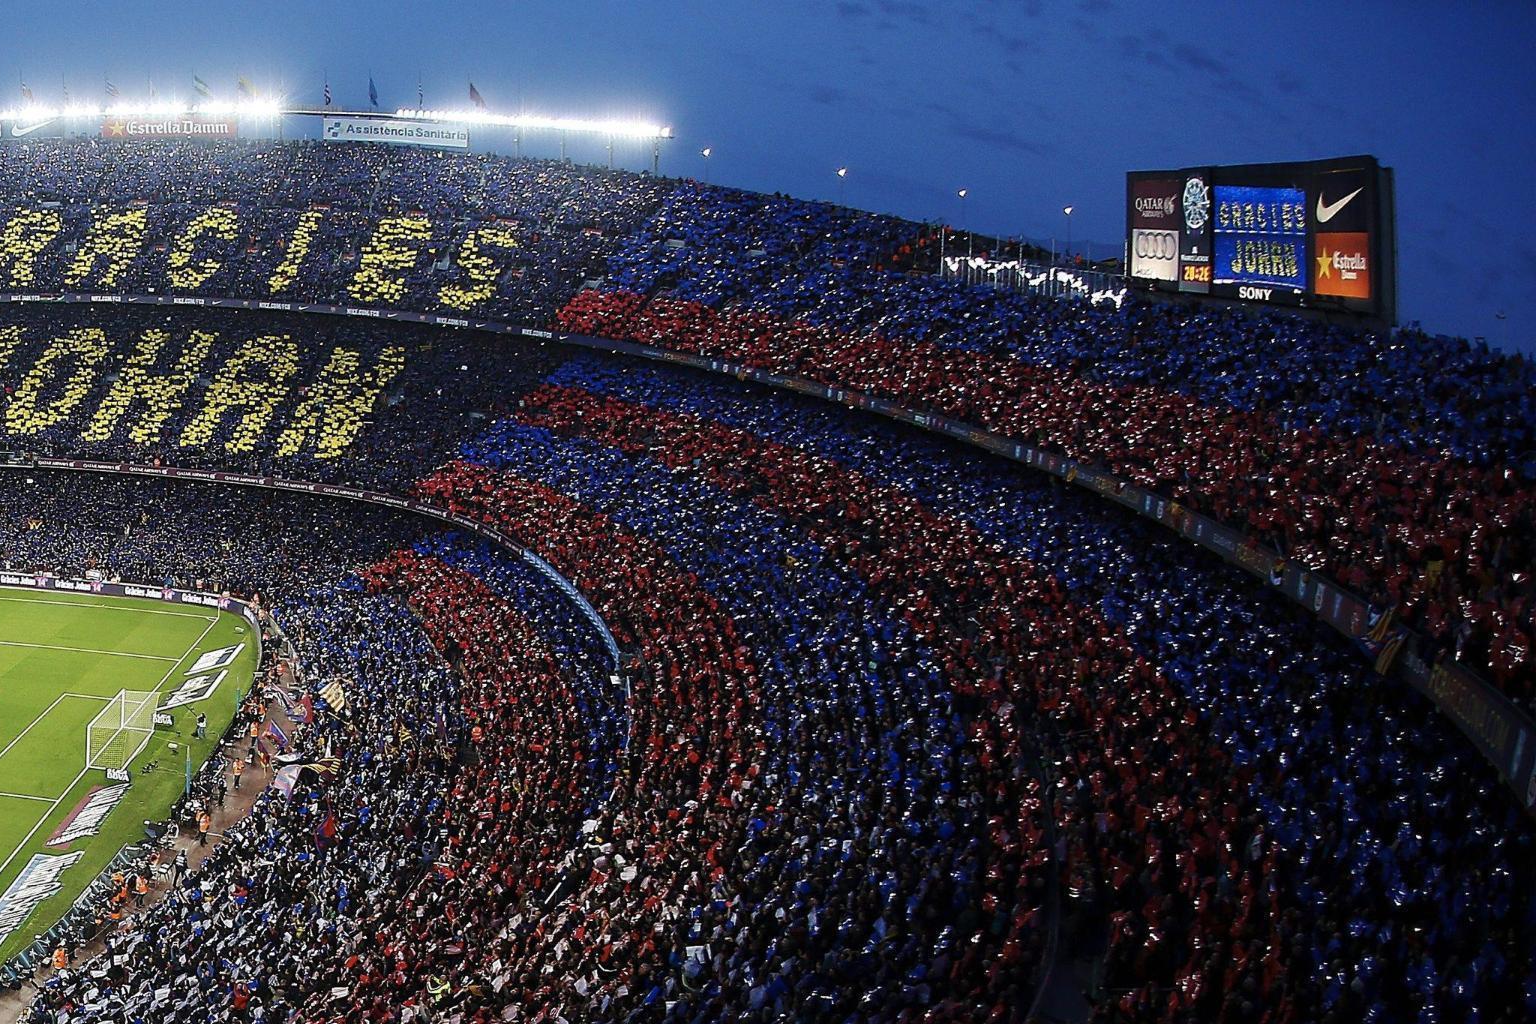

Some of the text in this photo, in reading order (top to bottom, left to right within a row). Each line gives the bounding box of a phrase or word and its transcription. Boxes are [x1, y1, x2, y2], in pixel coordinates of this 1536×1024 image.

[126, 120, 229, 135] Estrella Damm
[346, 124, 466, 141] Assistència Sanitària
[1135, 198, 1164, 211] QATAR
[1333, 251, 1366, 270] Estrella
[1239, 286, 1272, 300] SONY
